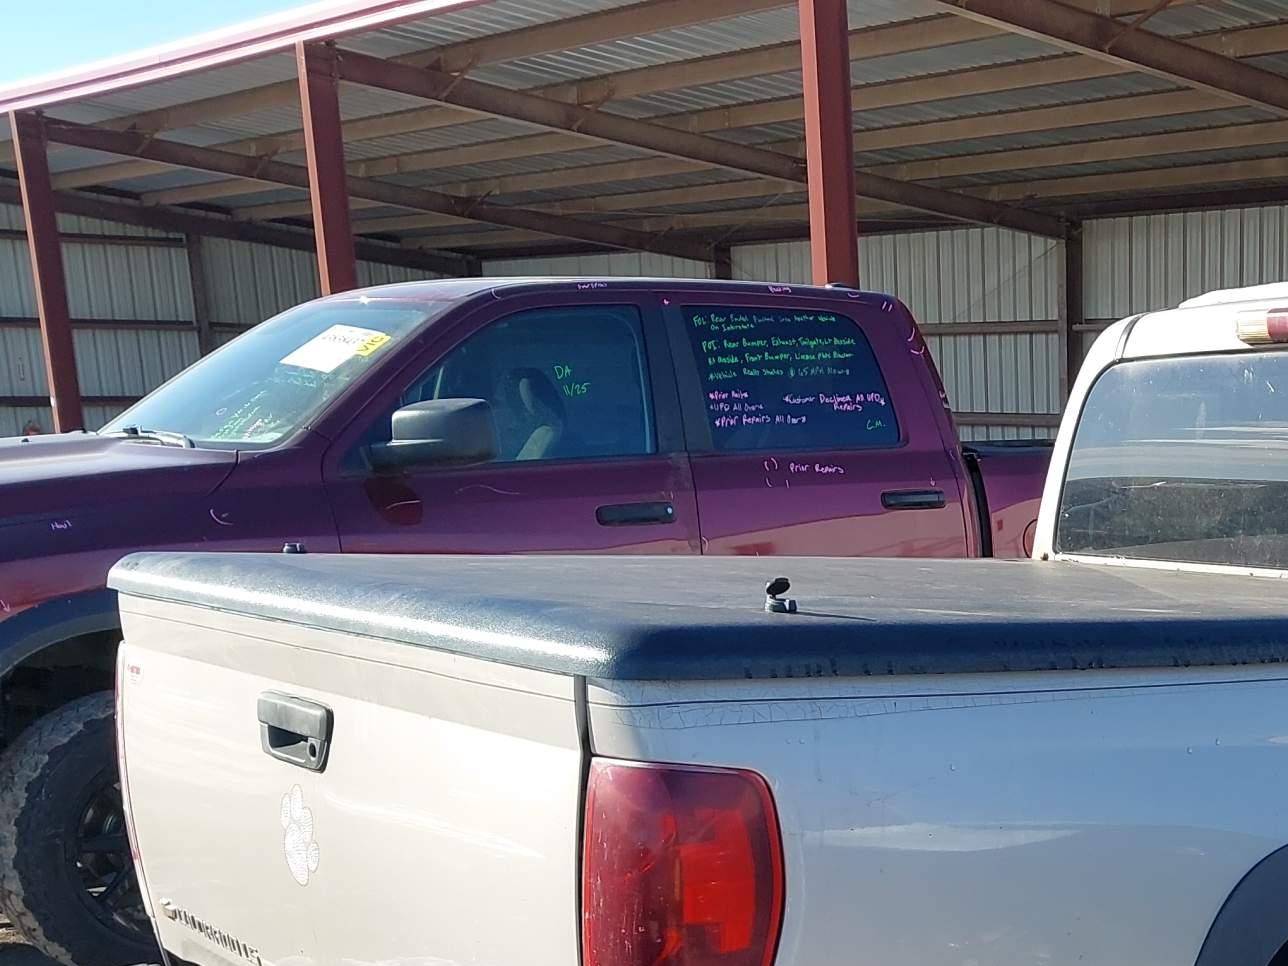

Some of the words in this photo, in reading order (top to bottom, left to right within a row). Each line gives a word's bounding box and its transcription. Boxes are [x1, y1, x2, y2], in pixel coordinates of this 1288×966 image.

[553, 365, 572, 380] DA
[563, 382, 592, 397] 11/25
[742, 413, 771, 425] Repairs
[789, 462, 810, 473] Prior
[814, 463, 845, 474] Repairs
